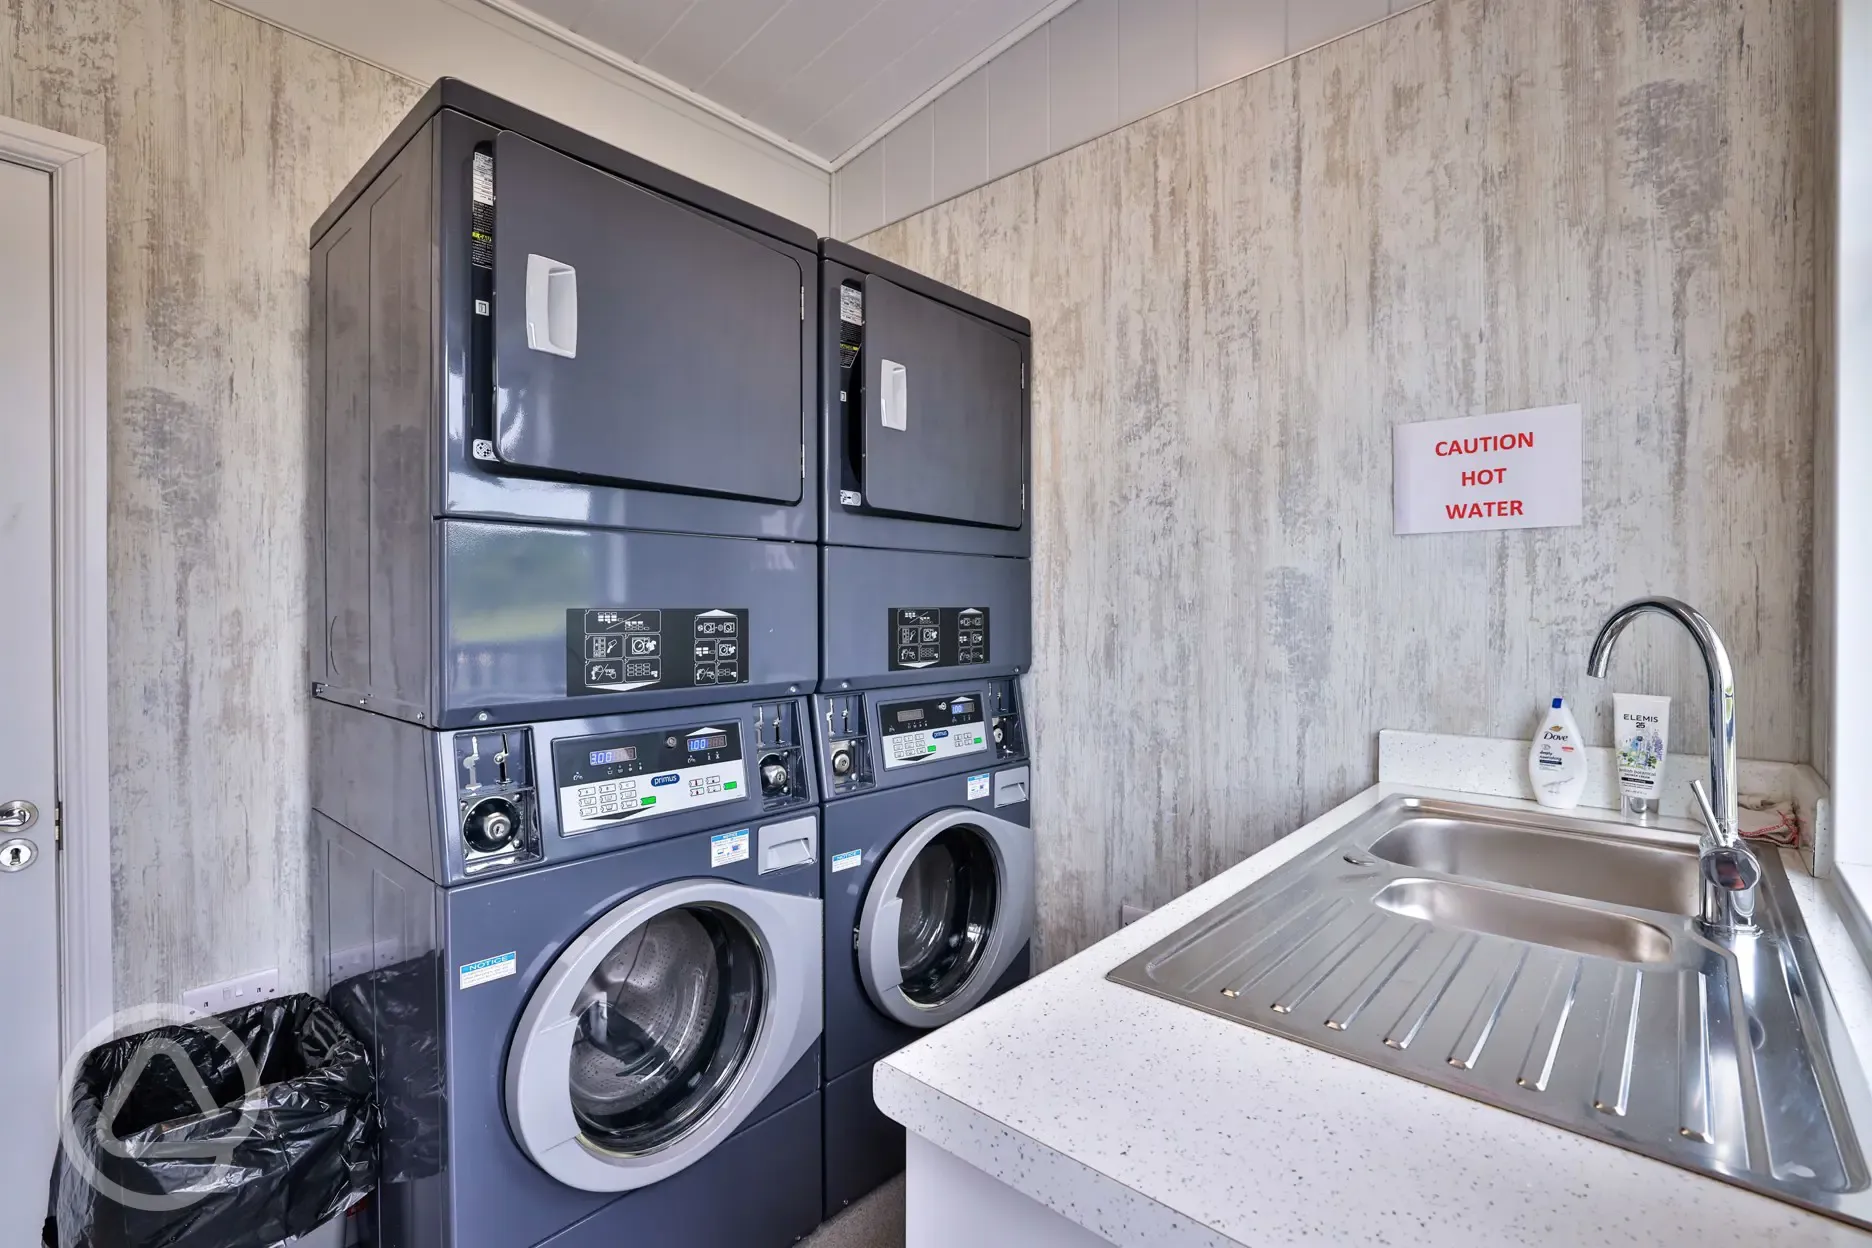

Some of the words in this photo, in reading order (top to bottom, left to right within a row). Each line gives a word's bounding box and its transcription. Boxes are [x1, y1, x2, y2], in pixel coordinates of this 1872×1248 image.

[1435, 431, 1534, 457] CAUTION
[1461, 467, 1507, 487] HOT
[1445, 500, 1524, 520] WATER
[1623, 713, 1659, 723] ELEMIS
[1543, 731, 1568, 741] Dove
[654, 774, 677, 786] primus
[469, 955, 509, 971] NOTICE
